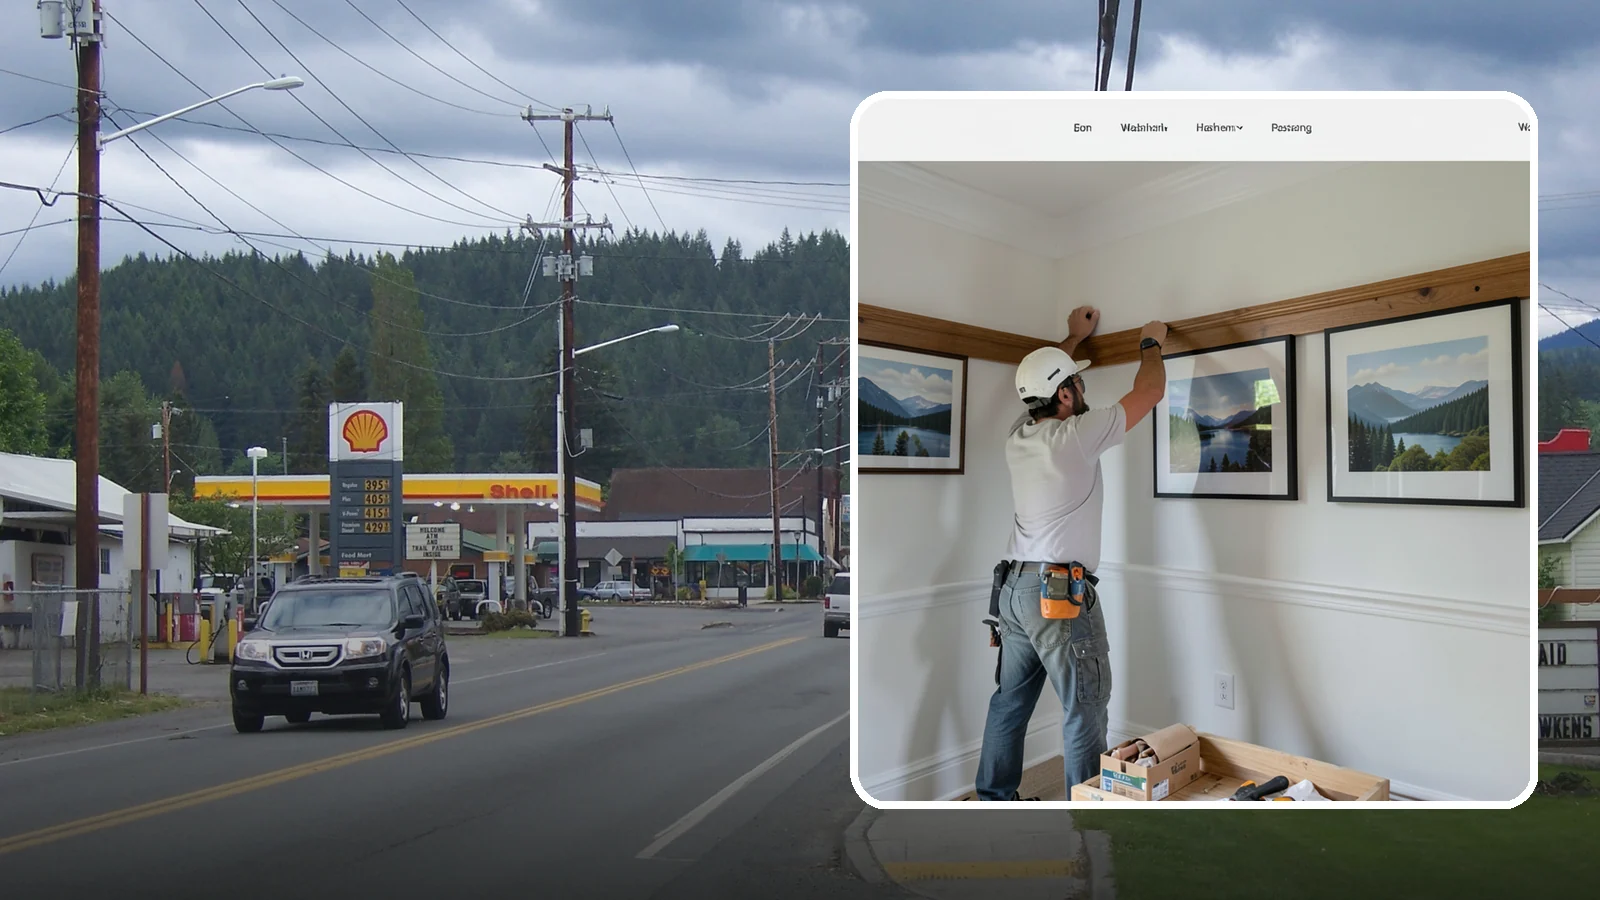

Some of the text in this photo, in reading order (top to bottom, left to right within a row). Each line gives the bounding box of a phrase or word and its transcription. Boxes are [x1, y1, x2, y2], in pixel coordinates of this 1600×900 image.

[365, 480, 383, 490] 395
[490, 484, 547, 498] Shell
[365, 494, 384, 504] 405
[365, 508, 384, 518] 415
[365, 522, 384, 532] 429
